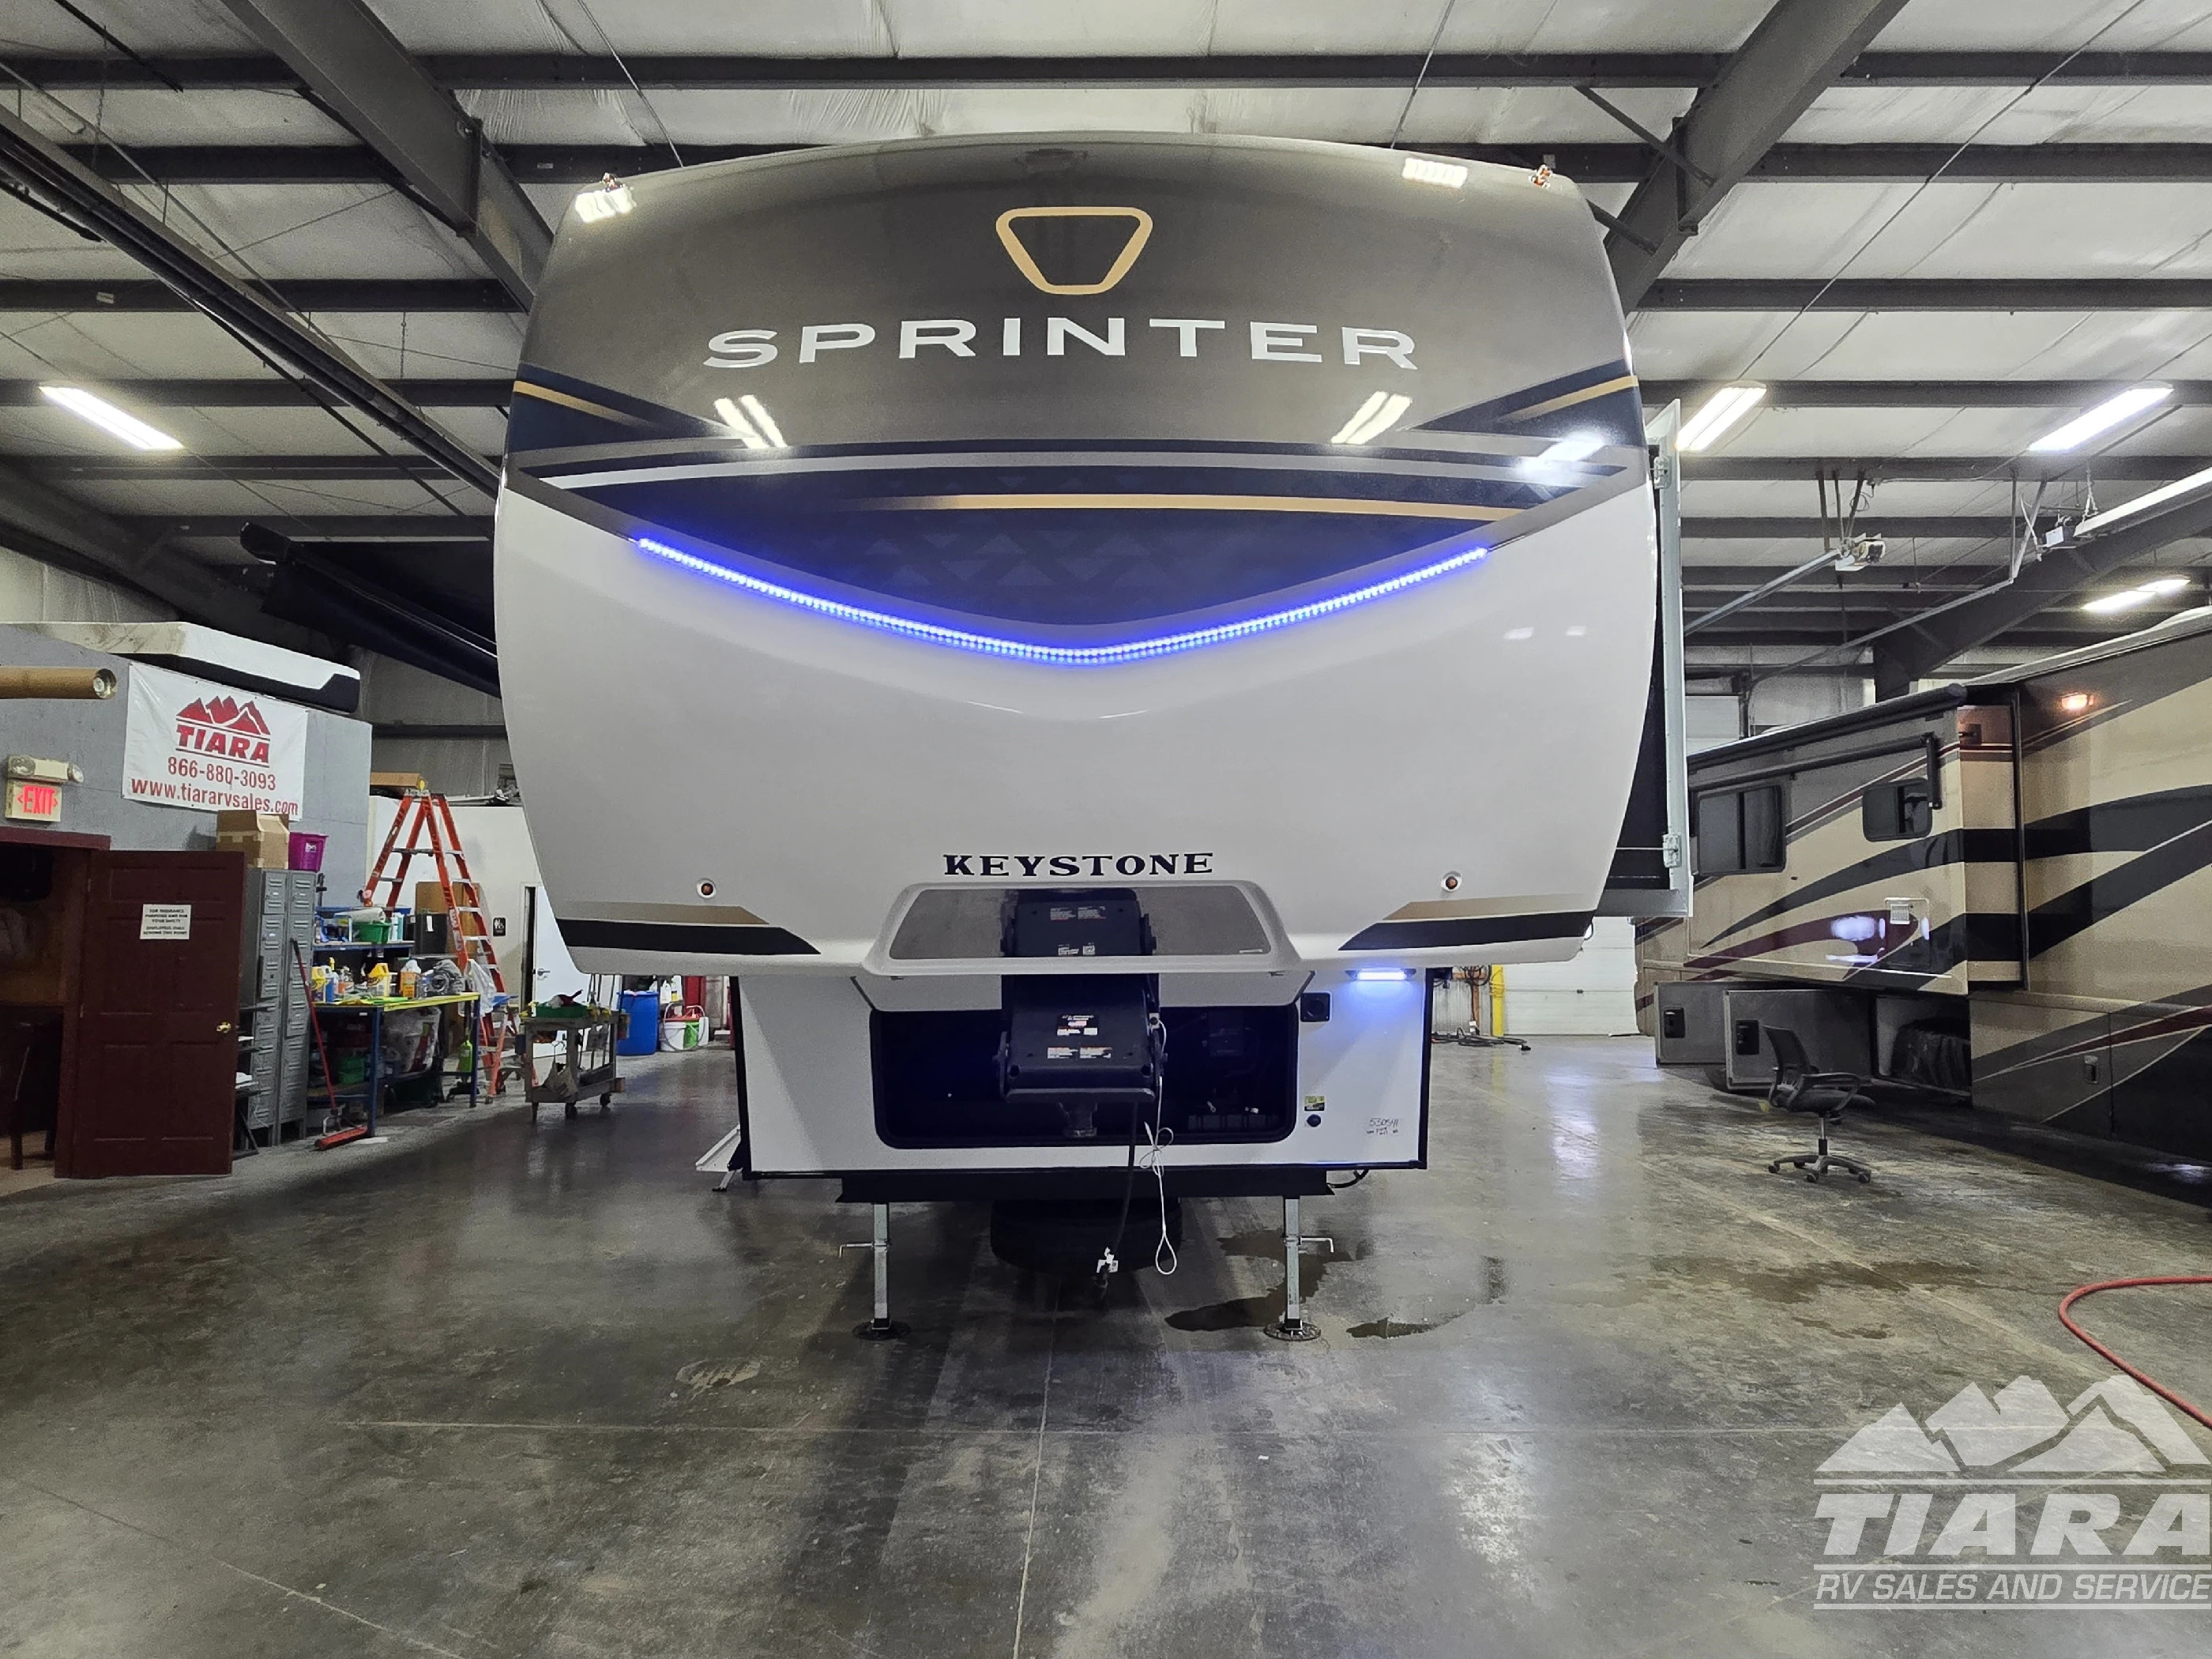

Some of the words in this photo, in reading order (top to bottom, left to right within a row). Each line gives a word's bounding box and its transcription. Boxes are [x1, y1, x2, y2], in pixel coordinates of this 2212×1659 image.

[702, 318, 1418, 371] SPRINTER
[176, 724, 269, 764] TIARA
[167, 756, 276, 791] 866-880-3093
[23, 785, 55, 815] EXIT
[131, 778, 298, 816] www.tiararvsales.com
[944, 852, 1214, 877] KEYSTONE
